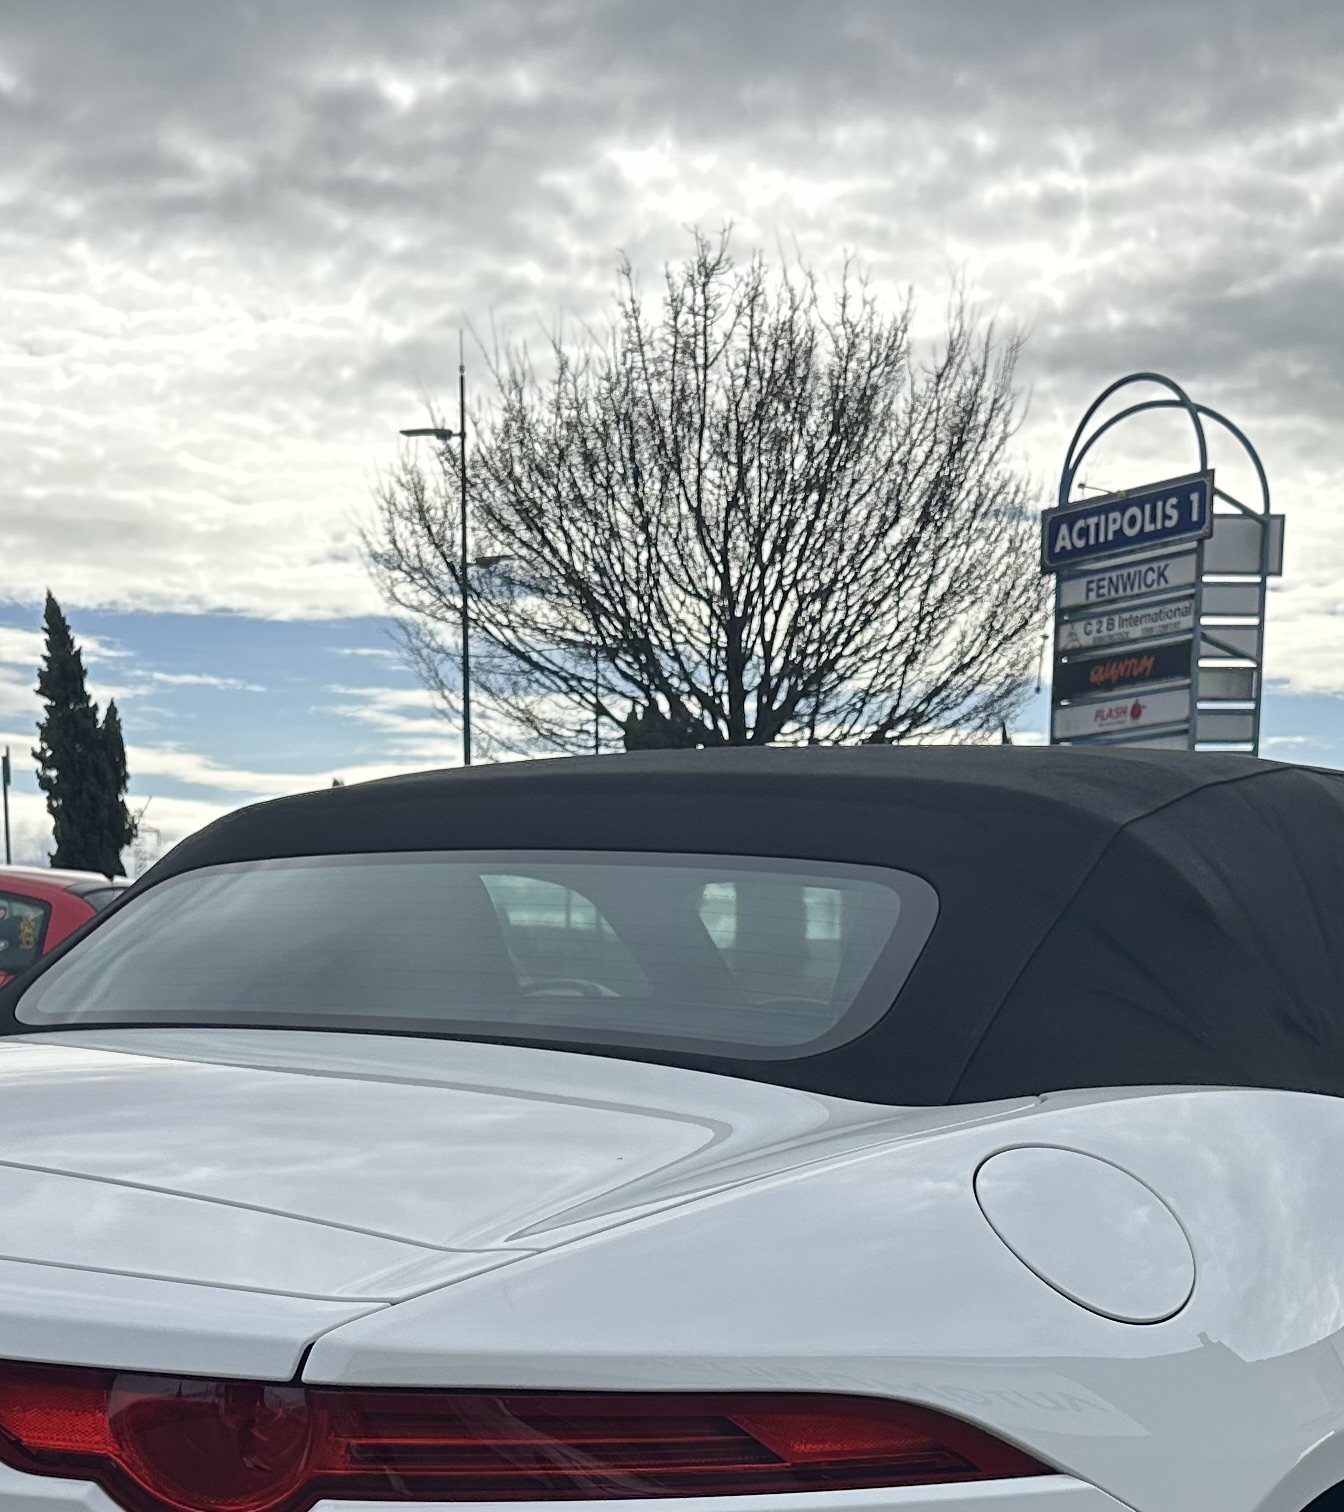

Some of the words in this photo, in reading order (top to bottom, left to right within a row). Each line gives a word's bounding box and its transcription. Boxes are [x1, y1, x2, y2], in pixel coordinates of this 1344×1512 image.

[1054, 497, 1179, 553] ACTIPOLIS
[1189, 492, 1200, 522] 1
[1085, 563, 1170, 601] FENWICK
[1083, 621, 1093, 636] C
[1095, 620, 1103, 634] 2
[1118, 601, 1193, 629] International
